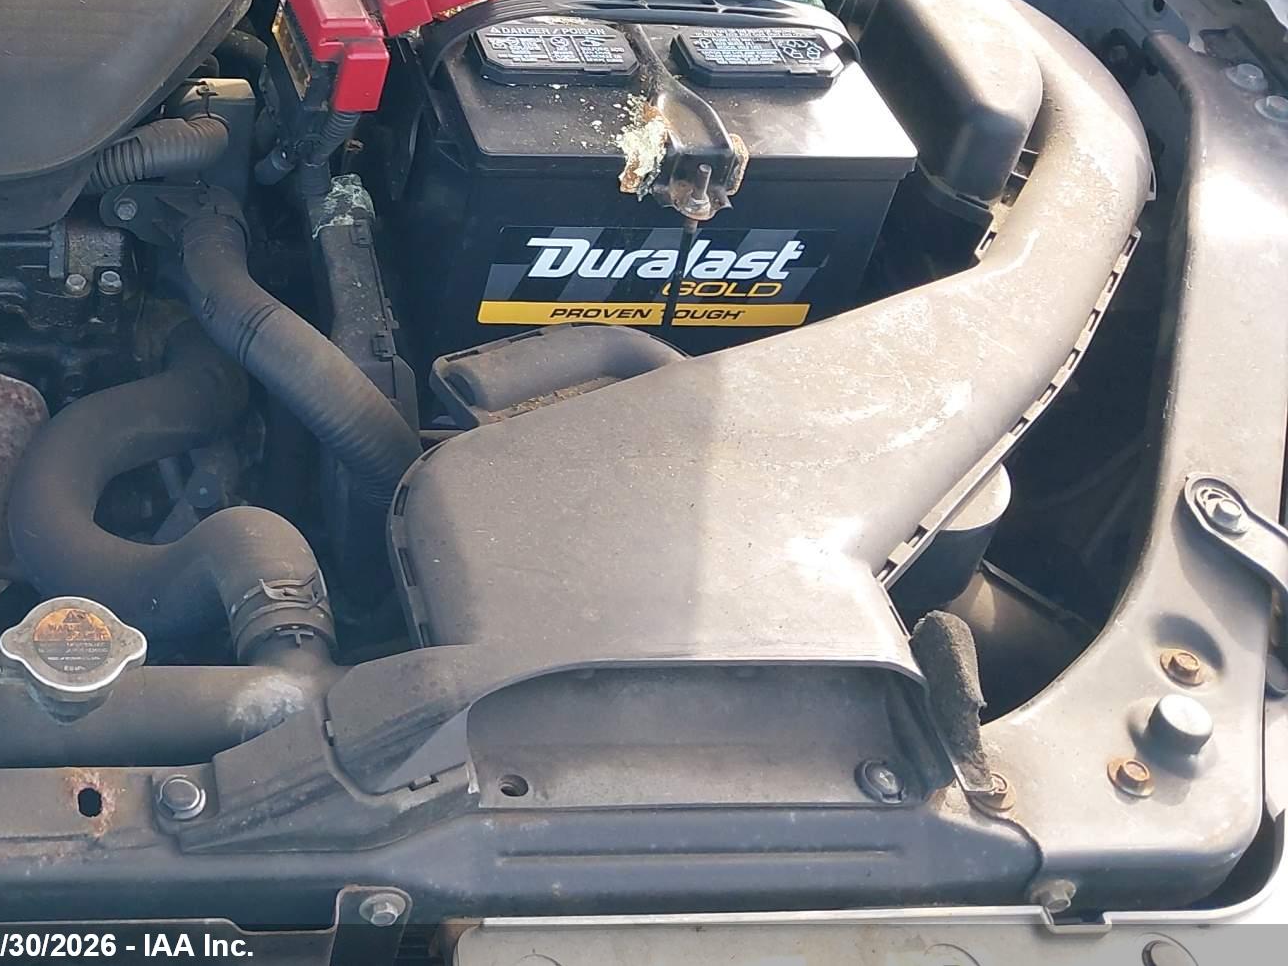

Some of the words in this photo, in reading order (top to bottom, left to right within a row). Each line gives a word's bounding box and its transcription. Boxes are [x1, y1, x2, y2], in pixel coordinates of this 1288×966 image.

[500, 26, 549, 35] DANGER
[561, 27, 605, 35] POISON
[662, 281, 784, 298] GOLD
[550, 307, 653, 319] PROVEN
[661, 308, 742, 320] OUGH
